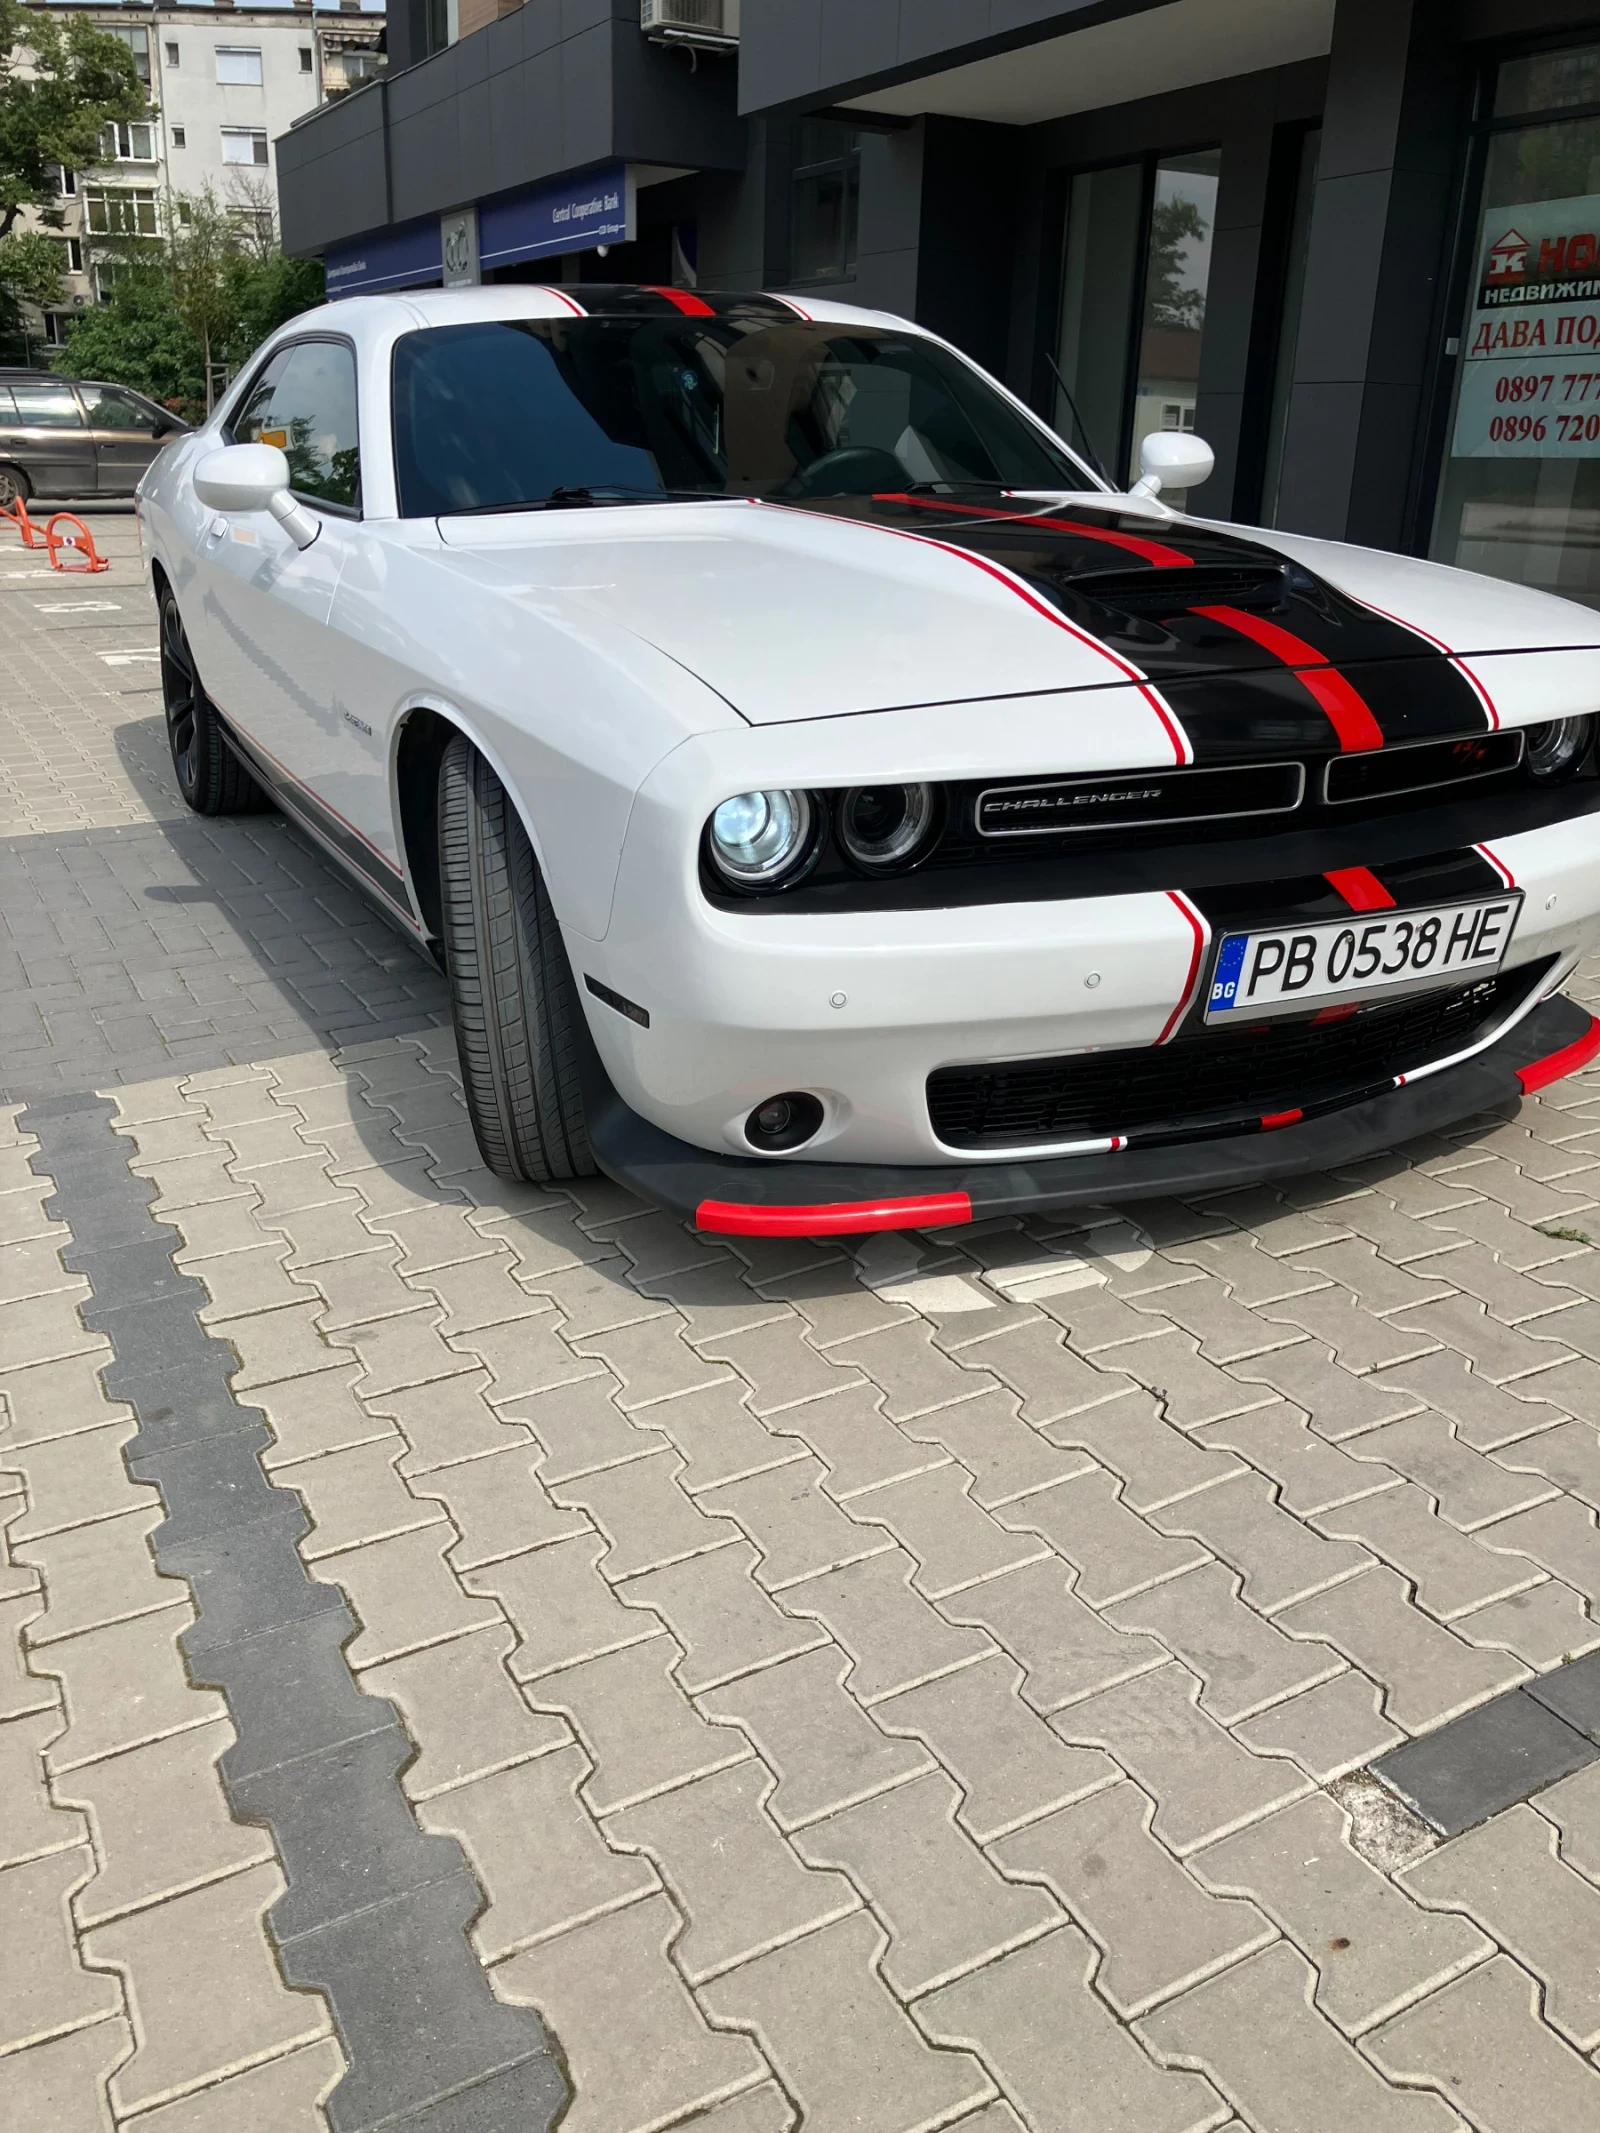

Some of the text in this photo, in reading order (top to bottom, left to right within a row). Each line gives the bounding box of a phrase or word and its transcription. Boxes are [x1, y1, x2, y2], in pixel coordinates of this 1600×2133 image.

[553, 192, 619, 223] Central Cooperative Bank
[1538, 233, 1600, 273] НО
[1471, 318, 1547, 356] ДАВА
[1495, 374, 1555, 403] 0897
[1489, 414, 1600, 442] 0896 720
[983, 789, 1162, 812] CHALLENGER
[1246, 905, 1509, 997] PB 0538 HE
[1211, 982, 1235, 1000] BG
